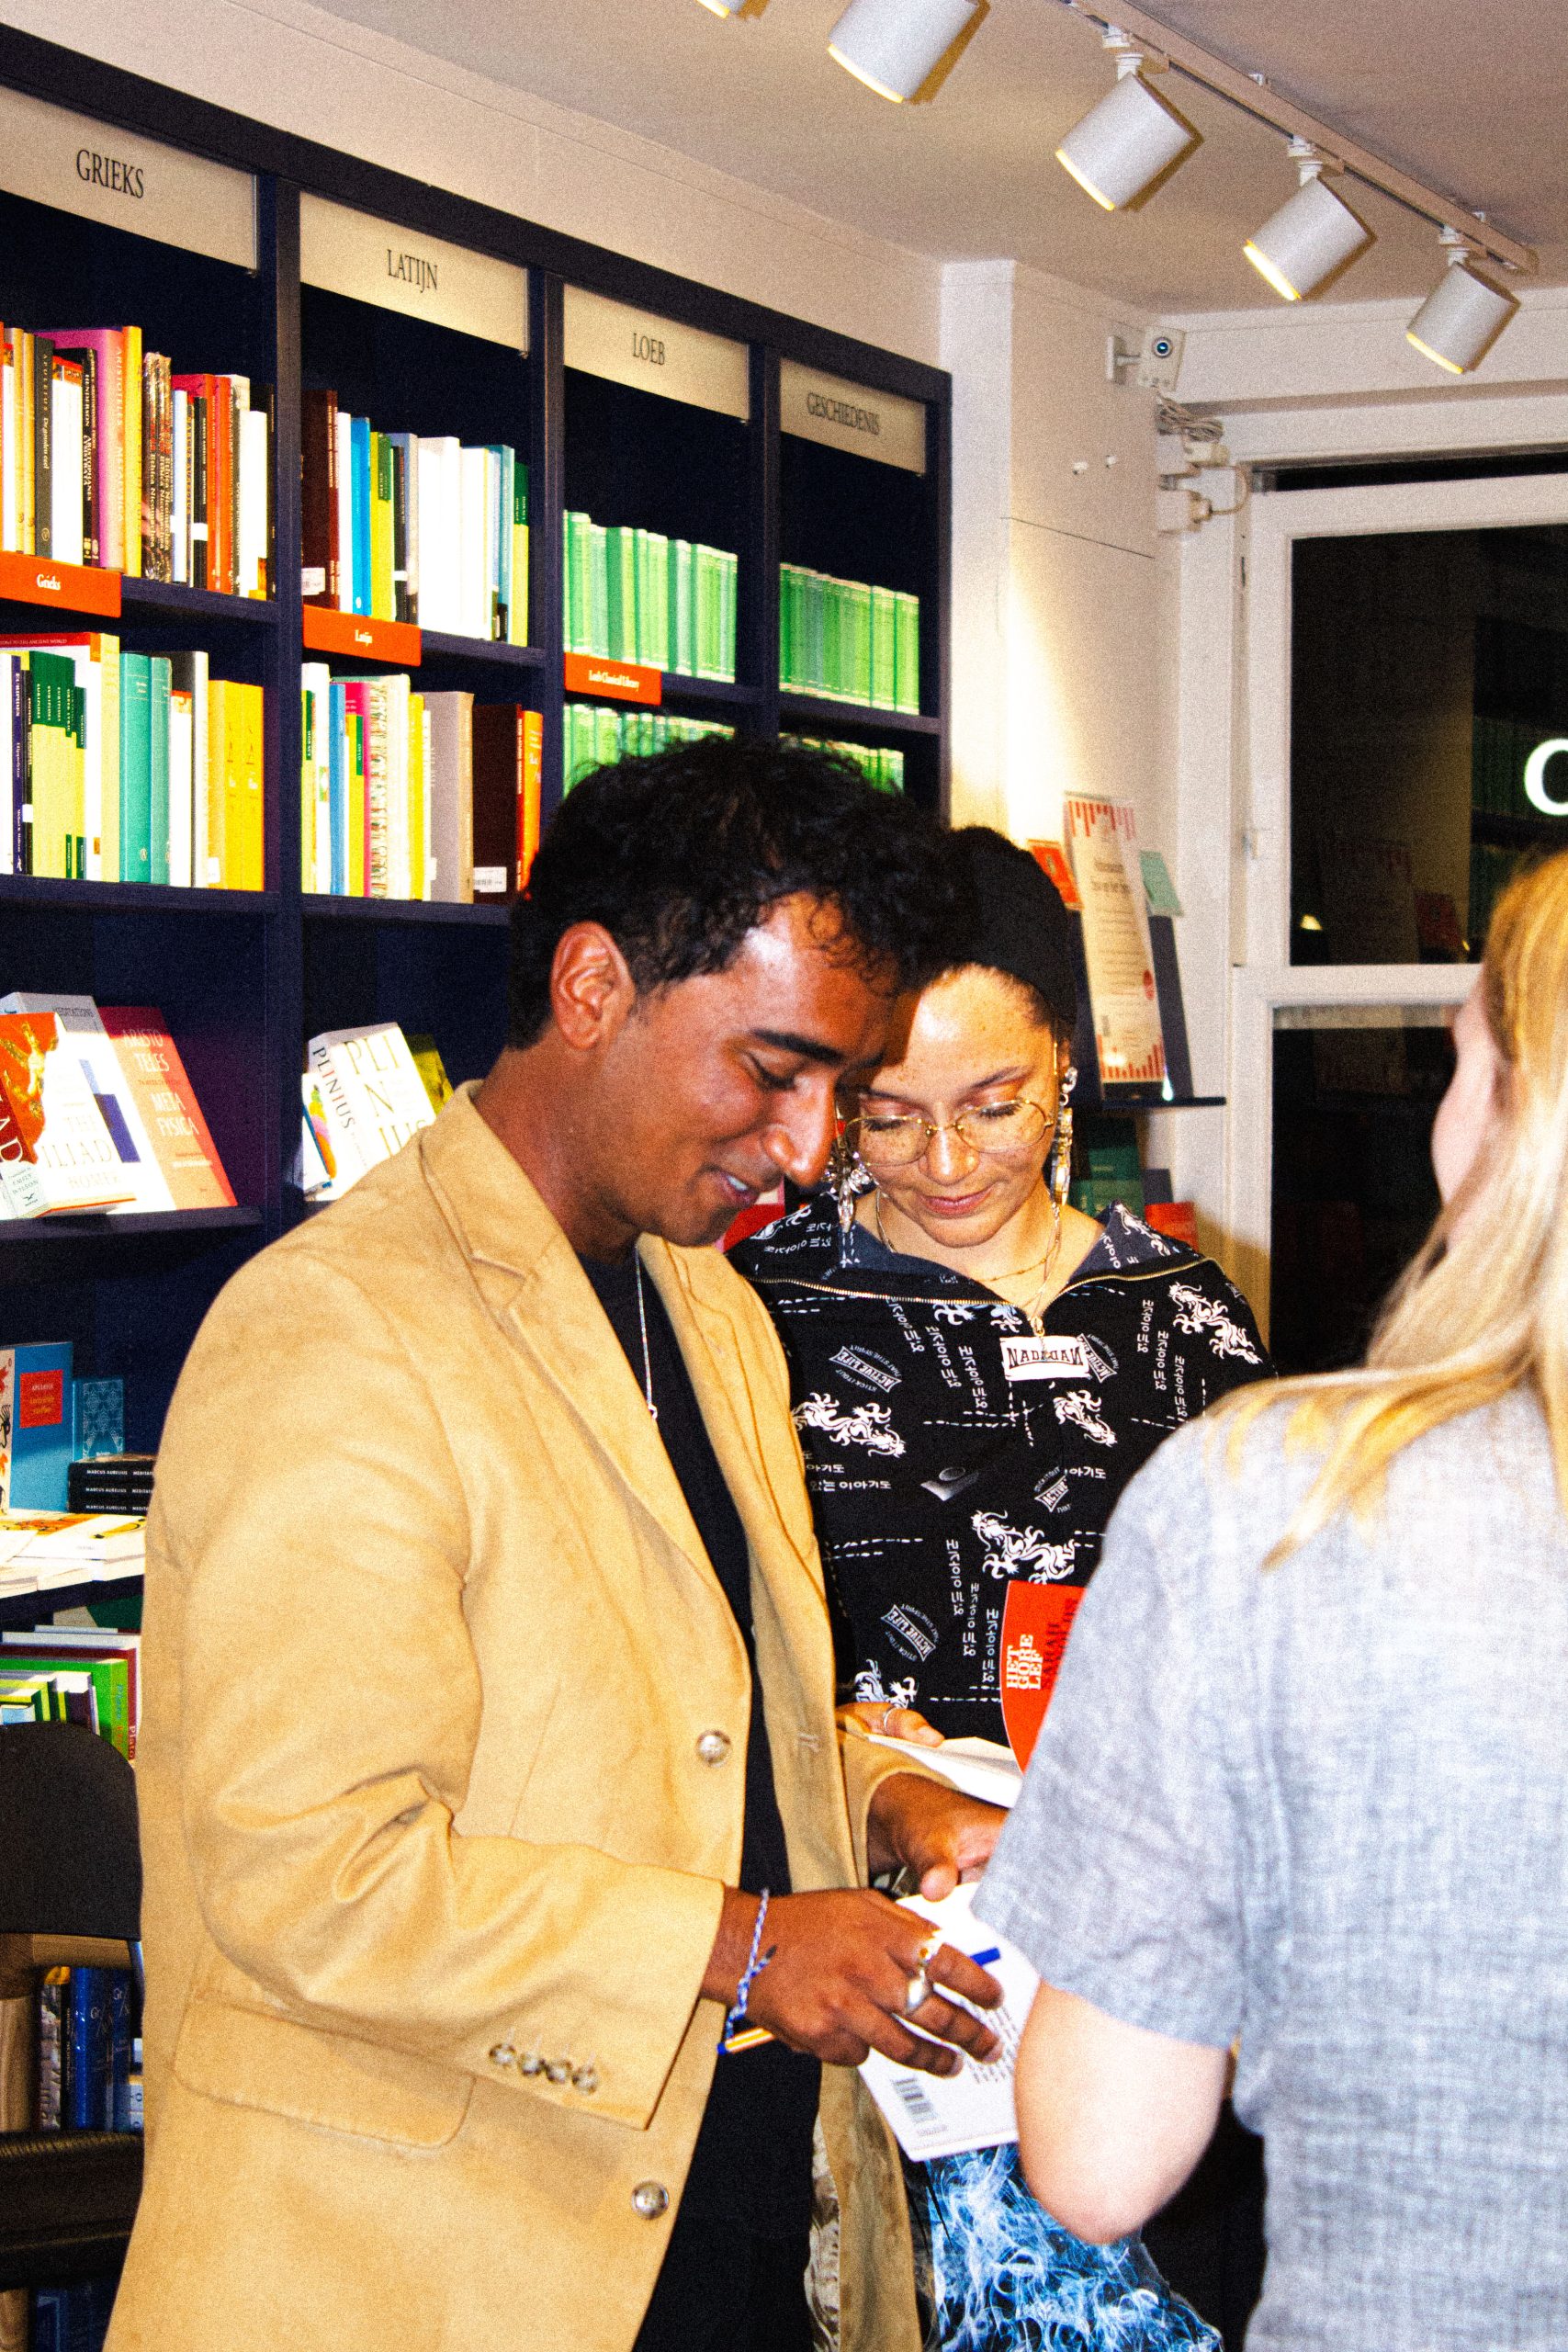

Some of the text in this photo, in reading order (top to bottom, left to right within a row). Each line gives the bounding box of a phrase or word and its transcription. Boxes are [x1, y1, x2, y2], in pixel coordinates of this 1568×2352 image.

[76, 149, 144, 199] GRIEKS
[387, 248, 439, 293] LATIJN
[633, 332, 665, 367] LOEB
[806, 391, 881, 435] GESCHIEDENIS
[37, 573, 62, 591] Grieks
[355, 629, 373, 647] Latijn
[589, 669, 602, 683] Loeb
[623, 674, 640, 692] Library
[120, 1028, 164, 1048] ARISTO
[344, 1035, 400, 1075] PLI
[133, 1053, 170, 1073] TELES
[150, 1091, 186, 1112] META
[312, 1046, 355, 1129] PLINIUS
[364, 1080, 394, 1117] N
[62, 1114, 97, 1133] THE
[156, 1116, 199, 1136] FYSICA
[41, 1139, 113, 1169] ILIAD
[837, 1350, 895, 1390] ACTIVE LIFE
[1084, 1350, 1111, 1378] ACTIVE
[1043, 1479, 1068, 1508] ACTIVE
[886, 1611, 931, 1655] ACTIVE LIFE
[1006, 1645, 1021, 1689] HET
[1017, 1634, 1033, 1690] GORE
[1028, 1648, 1043, 1690] LEF
